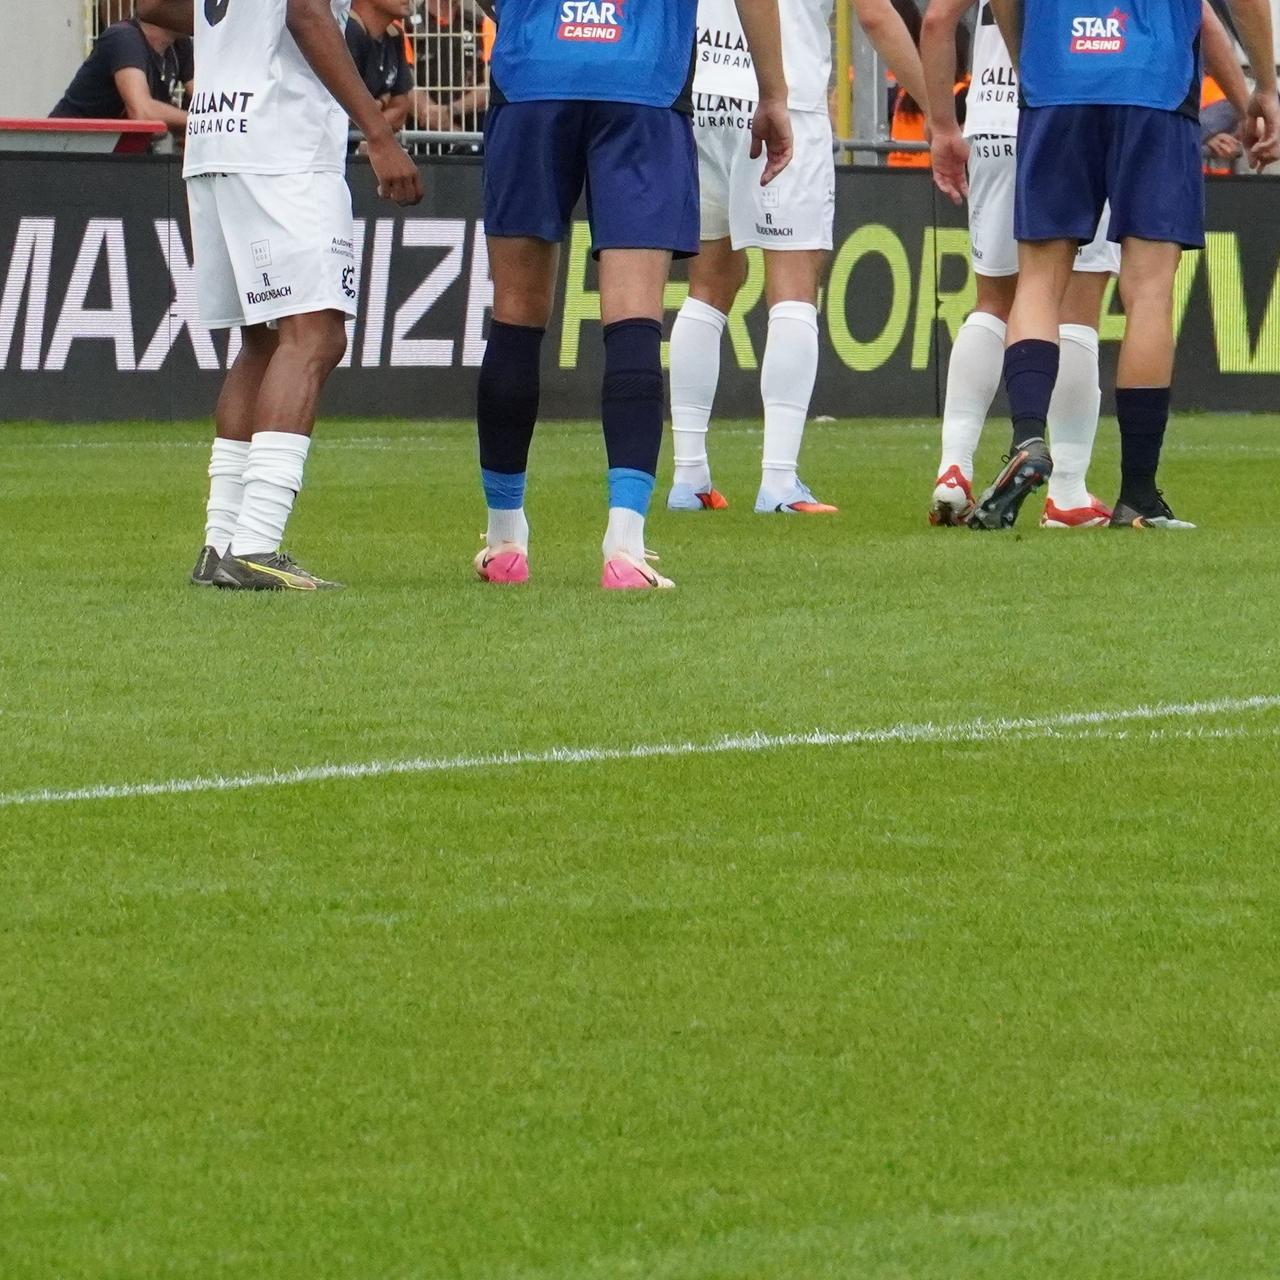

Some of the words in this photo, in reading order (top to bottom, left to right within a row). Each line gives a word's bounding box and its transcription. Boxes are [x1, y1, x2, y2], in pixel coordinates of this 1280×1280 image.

[560, 1, 618, 25] STAR
[564, 26, 616, 39] CASINO
[1071, 17, 1122, 37] STAR
[1076, 40, 1120, 50] CASINO
[981, 67, 1016, 86] CALL
[190, 91, 254, 114] ALLANT
[188, 119, 248, 135] SURANCE
